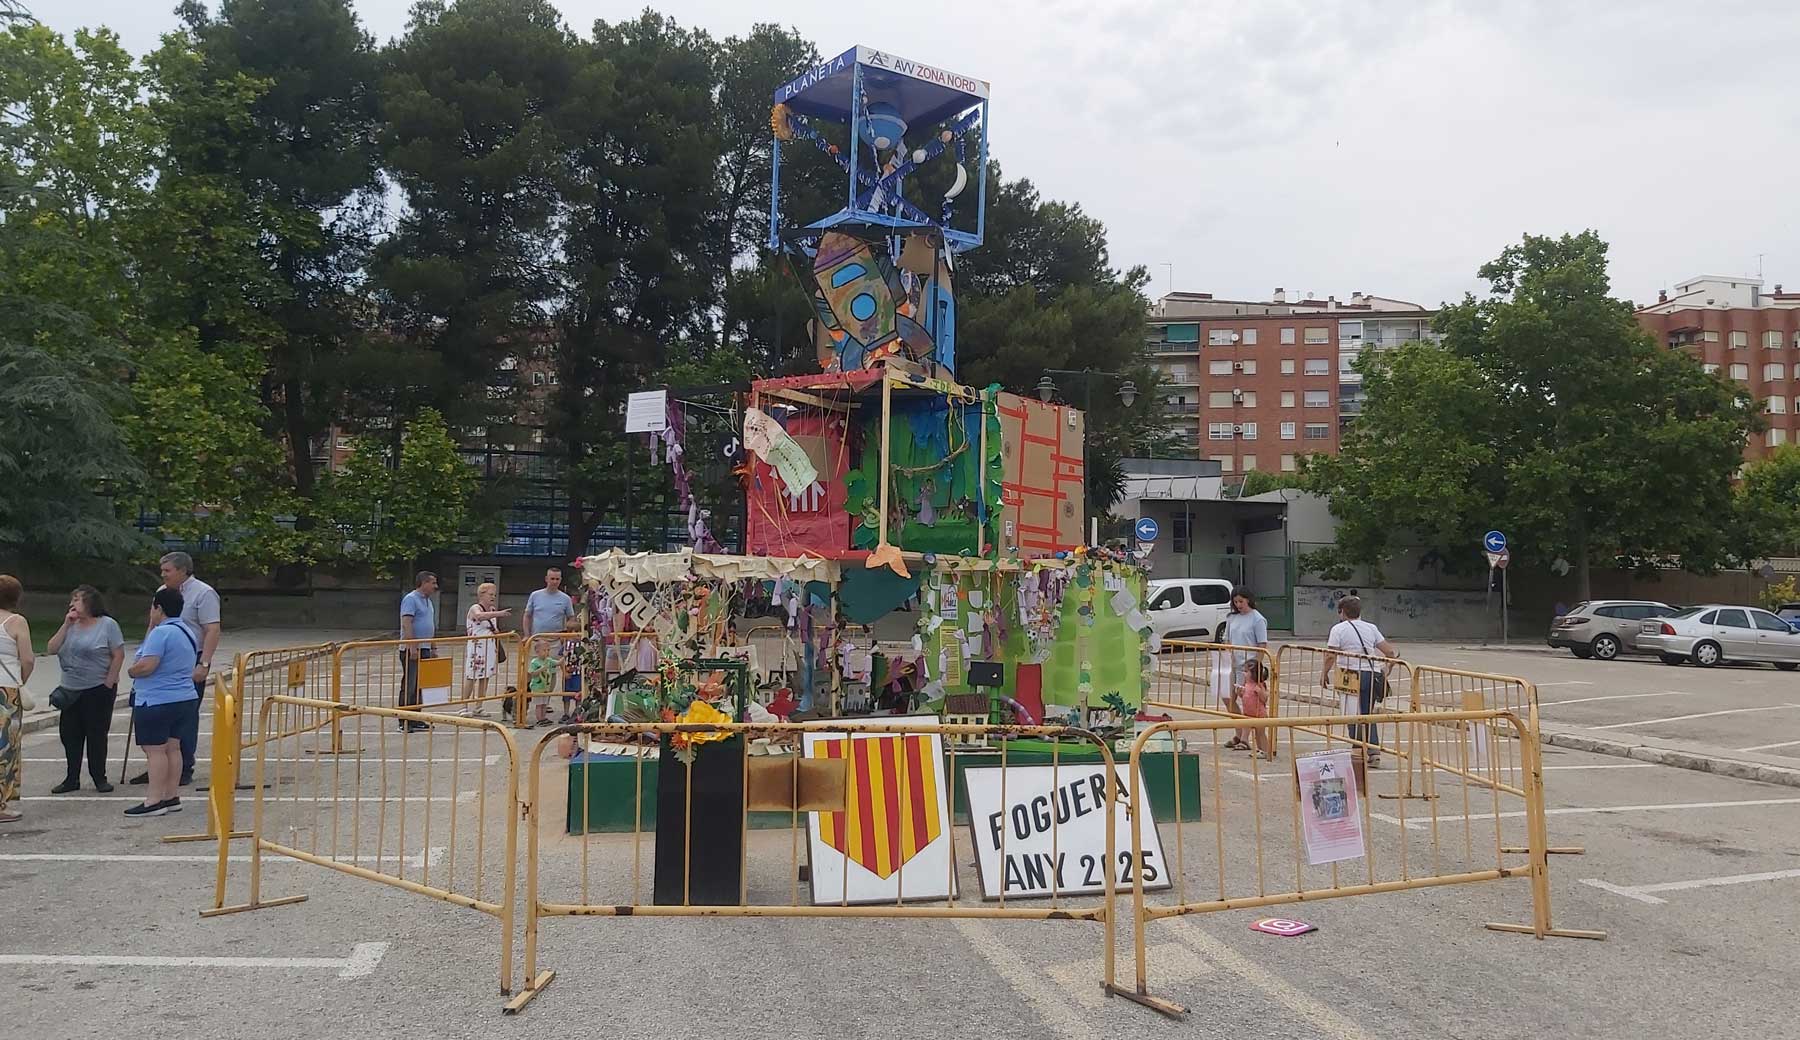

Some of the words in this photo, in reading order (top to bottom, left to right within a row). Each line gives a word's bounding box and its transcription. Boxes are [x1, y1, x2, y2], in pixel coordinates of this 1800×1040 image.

[785, 56, 845, 99] PLANETA
[894, 59, 915, 75] AVV
[917, 65, 946, 84] ZONA
[947, 74, 976, 92] NORD
[1004, 852, 1065, 891] ANY
